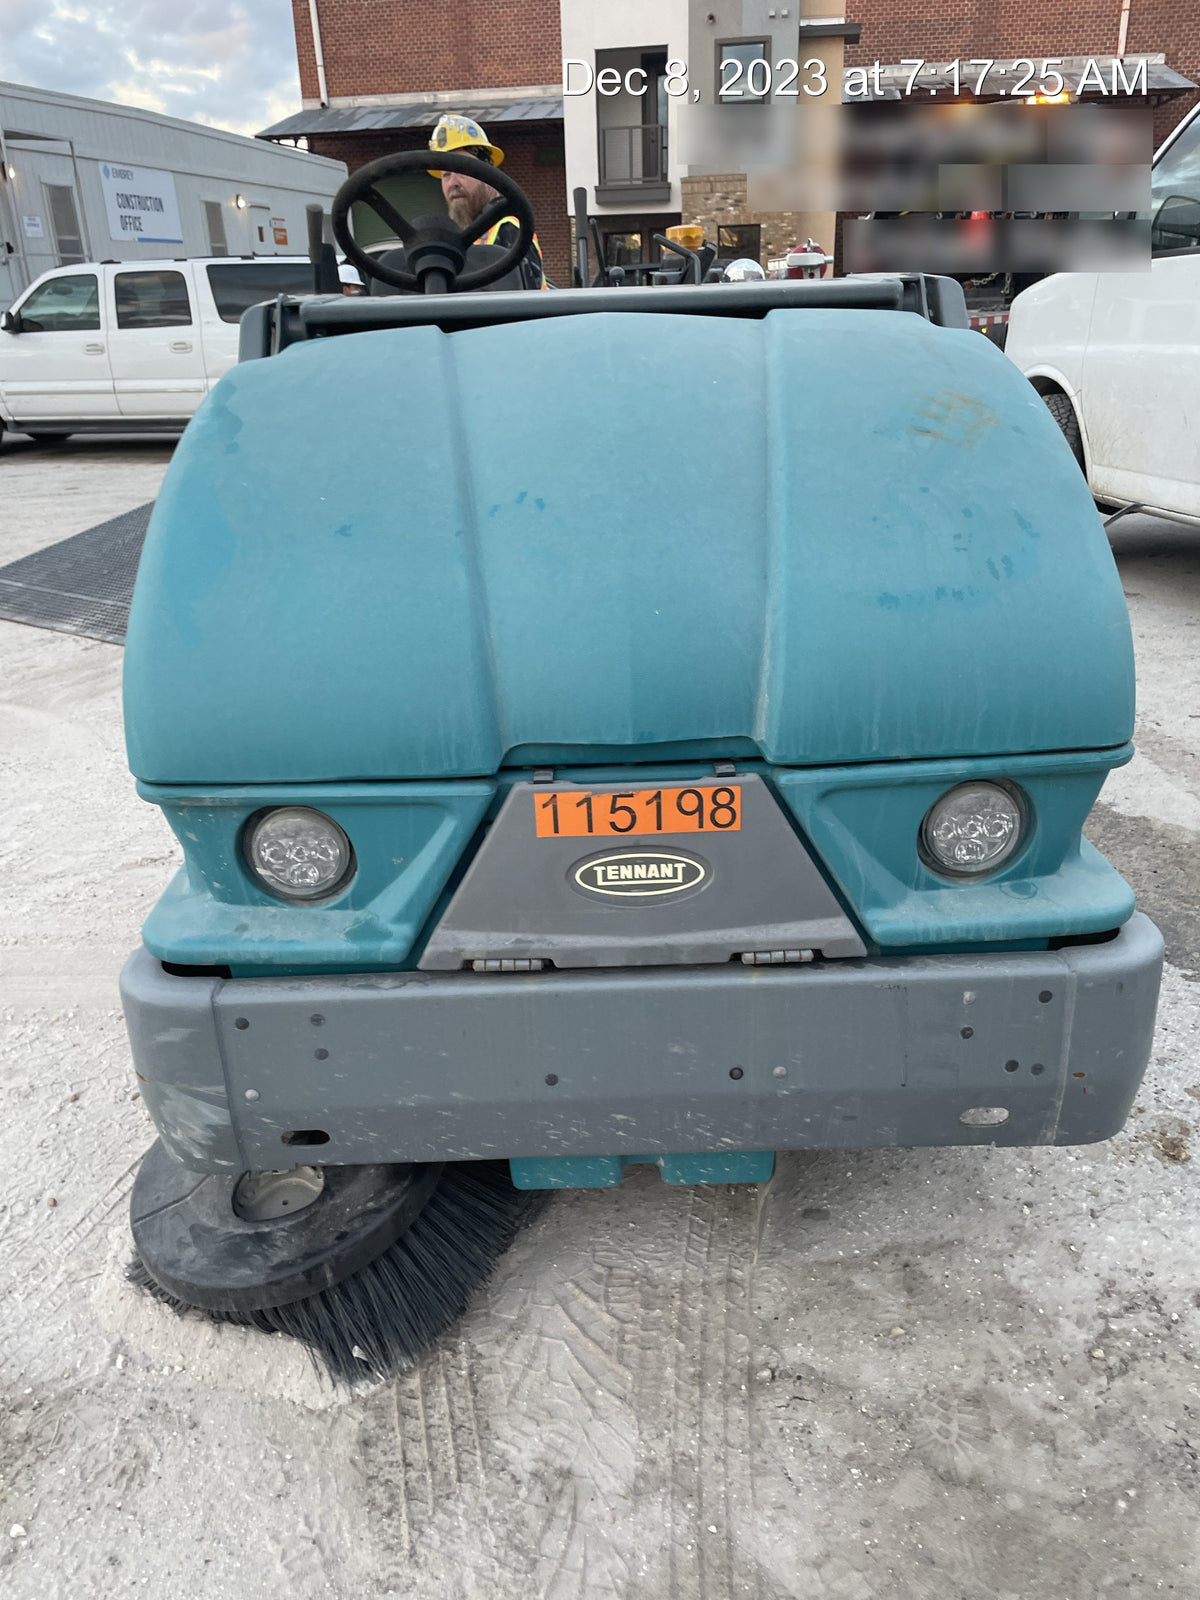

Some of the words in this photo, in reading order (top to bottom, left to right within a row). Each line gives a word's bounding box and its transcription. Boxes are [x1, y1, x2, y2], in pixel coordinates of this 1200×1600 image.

[111, 168, 134, 181] EMBREY
[116, 192, 165, 213] CONSTRUCTION
[120, 214, 144, 232] OFFICE
[541, 787, 737, 834] 115198
[593, 863, 687, 886] TENNANT
